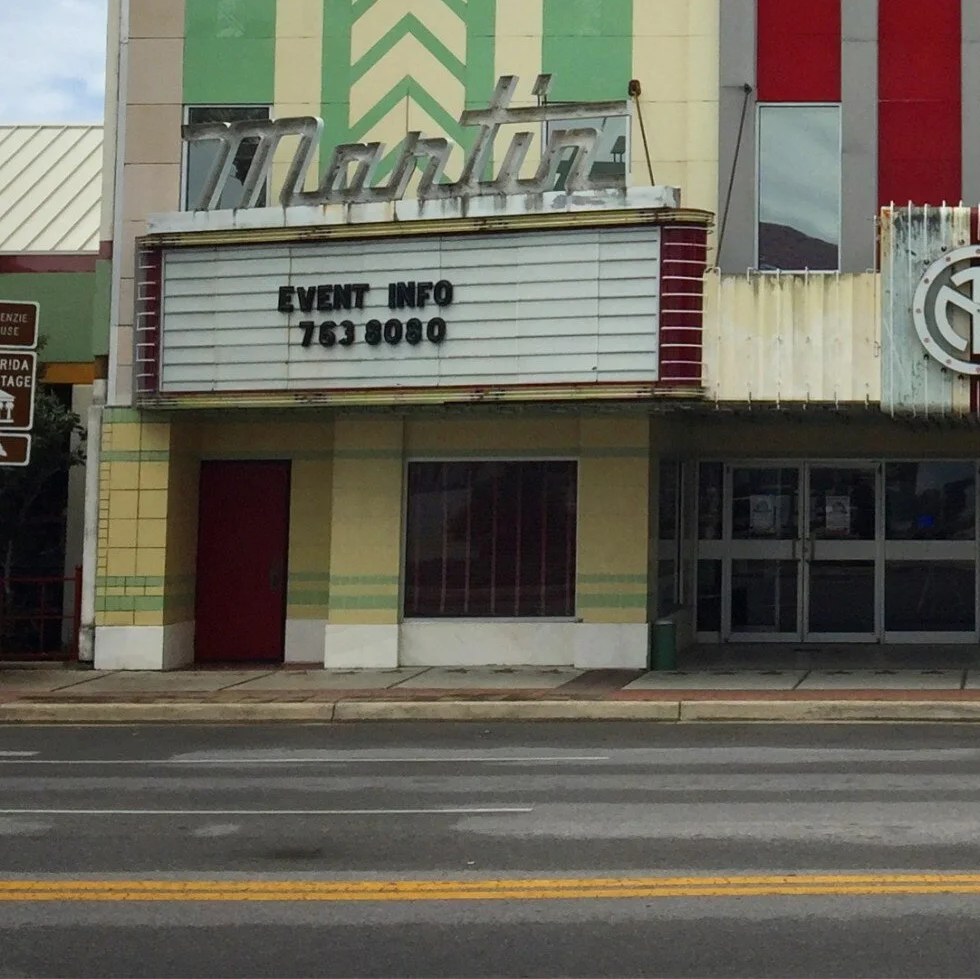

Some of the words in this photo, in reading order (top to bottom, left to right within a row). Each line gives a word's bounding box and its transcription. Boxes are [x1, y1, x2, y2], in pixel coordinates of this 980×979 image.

[182, 74, 630, 212] Martin
[278, 284, 369, 312] EVENT
[388, 279, 454, 310] INFO
